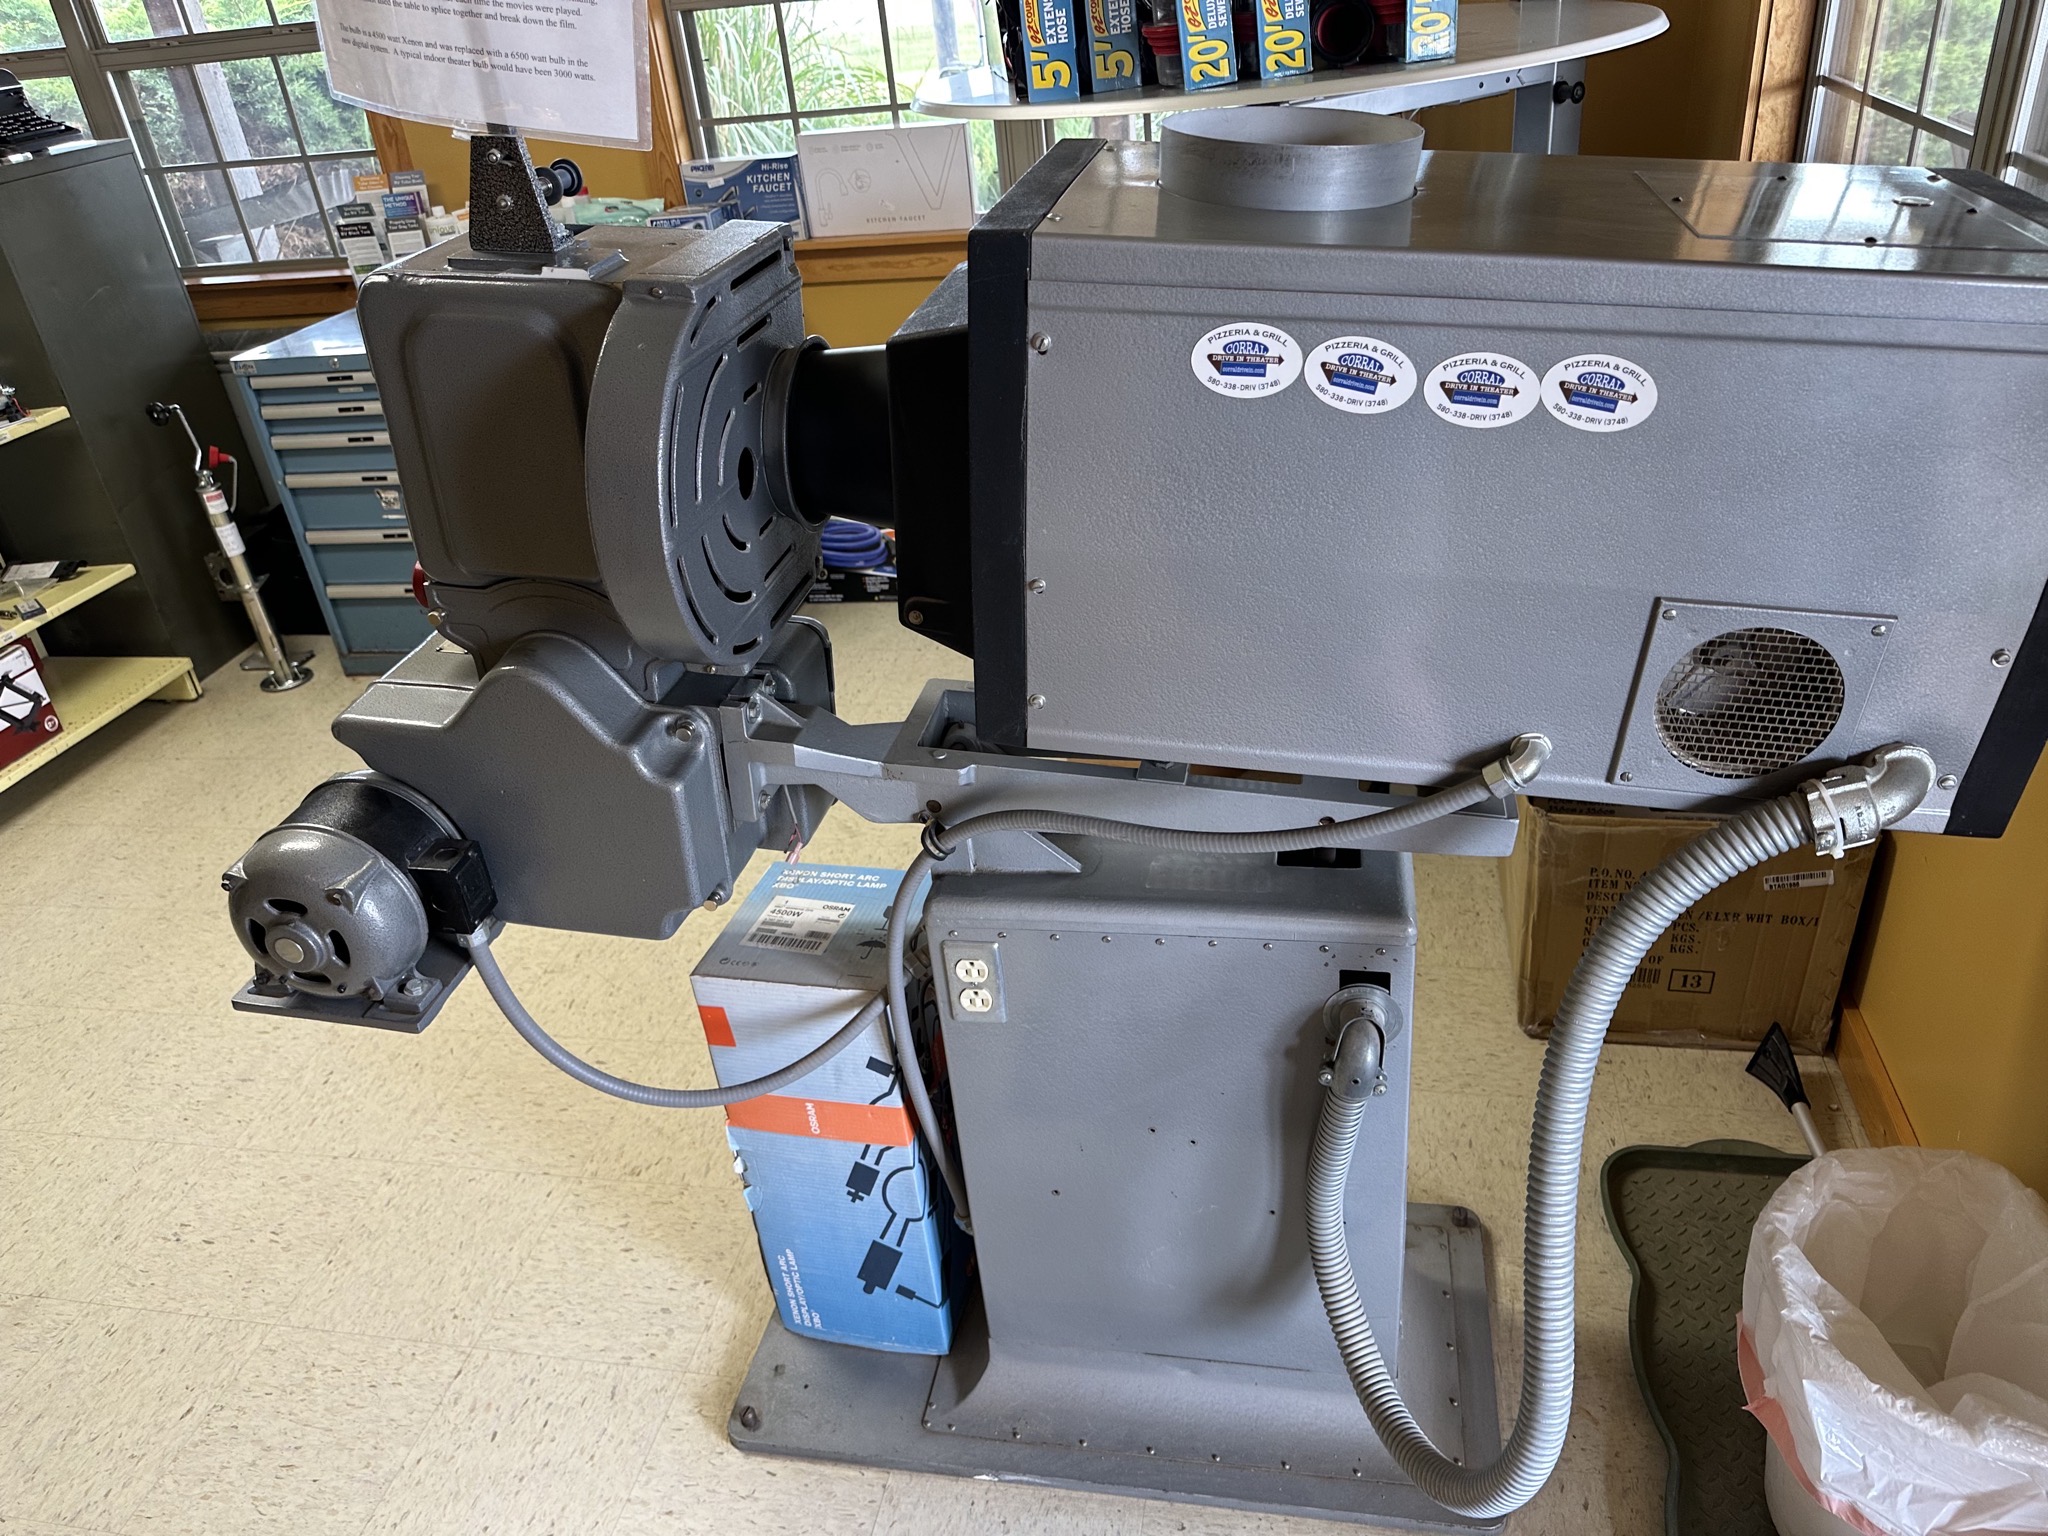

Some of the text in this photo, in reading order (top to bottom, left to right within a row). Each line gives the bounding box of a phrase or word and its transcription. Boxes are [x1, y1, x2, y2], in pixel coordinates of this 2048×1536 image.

[392, 0, 402, 8] the
[403, 1, 421, 11] table
[421, 4, 430, 12] to
[430, 6, 451, 15] splice
[453, 8, 483, 19] together
[484, 12, 498, 21] and
[499, 13, 521, 23] break
[522, 16, 544, 26] down
[546, 18, 558, 27] the
[559, 19, 577, 29] film.
[492, 0, 504, 8] the
[505, 2, 534, 12] movies
[535, 5, 554, 13] were
[555, 6, 583, 17] played.
[1119, 0, 1132, 33] HOSE
[1055, 8, 1069, 43] HOSE
[401, 36, 424, 47] Xenon
[424, 42, 438, 50] and
[438, 44, 454, 52] was
[454, 46, 485, 56] replaced
[486, 50, 504, 59] with
[510, 51, 530, 61] 6500
[531, 55, 548, 64] watt
[549, 56, 566, 65] bulb
[567, 58, 576, 67] in
[576, 59, 589, 68] the
[1264, 25, 1305, 72] 20'
[393, 48, 400, 56] A
[400, 50, 423, 62] typical
[423, 53, 446, 64] indoor
[447, 57, 471, 67] theater
[472, 59, 489, 69] bulb
[490, 62, 514, 73] would
[515, 64, 533, 75] have
[534, 66, 553, 77] been
[553, 69, 574, 79] 3000
[574, 73, 596, 82] watts.
[1093, 40, 1135, 79] 5'
[1187, 35, 1230, 83] 20'
[1030, 50, 1072, 90] 5'
[761, 163, 789, 171] Hi-Rise
[746, 172, 791, 184] KITCHEN
[752, 182, 793, 193] FAUCET
[1208, 329, 1250, 344] PIZZERIA
[1262, 331, 1288, 347] GRILL
[1226, 342, 1266, 354] CORRAL
[1325, 342, 1369, 352] PIZZERIA
[1381, 349, 1405, 369] GRILL
[1341, 355, 1381, 372] CORRAL
[1443, 358, 1488, 371] PIZZERIA
[1500, 362, 1526, 379] GRILL
[1326, 364, 1348, 373] DRIVE
[1360, 371, 1391, 383] THEATER
[1460, 371, 1502, 385] CORRAL
[1564, 360, 1610, 371] PIZZERIA
[1622, 367, 1647, 387] GRILL
[1207, 376, 1280, 390] 580-338-DRIV (3748)
[1480, 386, 1514, 394] THEATER
[1581, 374, 1621, 391] CORRAL
[1316, 384, 1388, 407] 580-338-DRIV (3748)
[1564, 383, 1587, 391] DRIVE
[1600, 390, 1633, 401] THEATER
[1437, 404, 1512, 421] 580-338-DRIV (3748)
[1553, 403, 1628, 425] 580-338-DRIV (3748)
[819, 871, 856, 880] SHORT
[1588, 879, 1619, 889] ITEM
[856, 882, 887, 890] LAMP
[770, 908, 803, 917] 4500W
[822, 904, 851, 912] OSRAM
[1746, 913, 1773, 924] WHT
[1672, 922, 1700, 933] PCS.
[1671, 934, 1702, 944] KGS.
[1669, 944, 1699, 954] KGS.
[1648, 955, 1664, 965] OF
[1680, 974, 1702, 988] 13
[805, 1102, 820, 1134] OSRAM
[778, 1254, 801, 1325] XENON SHORT ARC
[786, 1248, 812, 1327] DISPLAY/OPTIC LAMP
